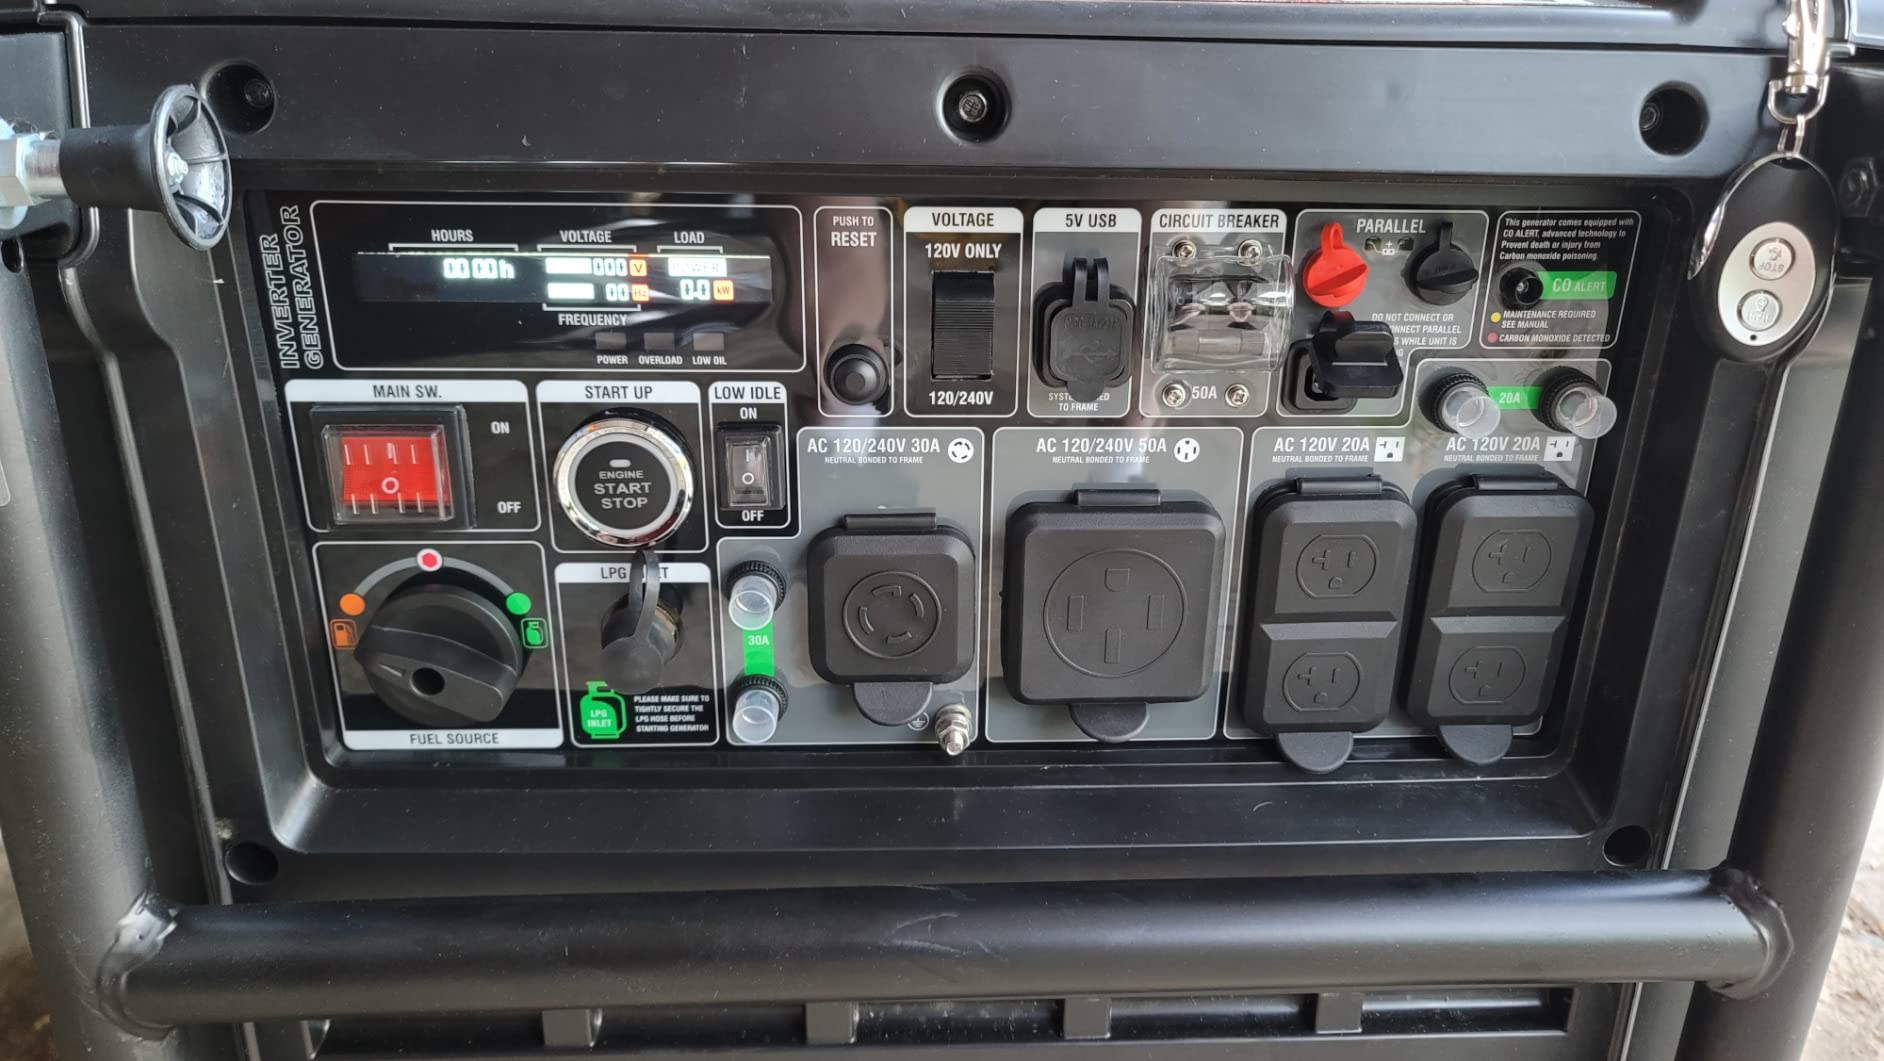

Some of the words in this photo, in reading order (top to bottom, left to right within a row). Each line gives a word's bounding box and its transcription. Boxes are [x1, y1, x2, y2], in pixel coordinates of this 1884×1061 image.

[832, 215, 861, 226] PUSH
[863, 215, 874, 226] TO
[932, 212, 995, 227] VOLTAGE
[1065, 214, 1084, 228] 5V
[1089, 214, 1117, 228] USB
[1159, 214, 1214, 228] CIRCUIT
[1217, 214, 1279, 228] BREAKER
[1505, 218, 1520, 226] This
[1521, 218, 1557, 228] generator
[1583, 218, 1617, 228] equipped
[1618, 218, 1634, 226] with
[1357, 218, 1427, 234] PARALLEL
[431, 230, 473, 242] HOURS
[560, 230, 612, 243] VOLTAGE
[674, 231, 705, 244] LOAD
[831, 231, 877, 247] RESET
[1503, 229, 1514, 238] CO
[1542, 229, 1577, 238] advanced
[1578, 229, 1617, 239] technology
[1618, 229, 1627, 238] to
[925, 243, 960, 259] 120V
[965, 243, 1002, 259] ONLY
[1501, 240, 1529, 249] Prevent
[1530, 240, 1551, 249] death
[1561, 240, 1583, 251] injury
[1583, 240, 1601, 249] from
[1499, 251, 1525, 260] Carbon
[1526, 251, 1561, 260] monoxide
[280, 205, 324, 369] GENERATOR
[1552, 278, 1572, 292] CO
[1574, 281, 1607, 292] ALERT
[260, 234, 300, 368] INVERTER
[558, 313, 627, 326] FREQUENCY
[1371, 313, 1384, 322] DO
[1385, 313, 1402, 322] NOT
[1403, 313, 1441, 322] CONNECT
[1442, 313, 1455, 322] OR
[1502, 310, 1557, 318] MAINTENANCE
[1558, 310, 1596, 318] REQUIRED
[1422, 325, 1461, 334] PARALLEL
[1501, 320, 1516, 328] SEE
[1517, 320, 1549, 328] MANUAL
[1401, 336, 1427, 345] WHILE
[1428, 336, 1447, 345] UNIT
[1448, 336, 1458, 345] IS
[1499, 334, 1530, 342] CARBON
[1531, 334, 1571, 342] MONOXIDE
[1572, 334, 1611, 342] DETECTED
[597, 355, 628, 364] POWER
[638, 355, 682, 364] OVERLOAD
[692, 356, 711, 365] LOW
[713, 356, 727, 365] OIL
[373, 385, 410, 398] MAIN
[415, 385, 442, 398] SW.
[585, 386, 629, 399] START
[633, 386, 653, 399] UP
[714, 387, 745, 400] LOW
[750, 387, 781, 400] IDLE
[1191, 386, 1217, 400] 50A
[929, 391, 993, 406] 120/240V
[1499, 392, 1520, 404] 20A
[1059, 402, 1069, 411] TO
[1071, 402, 1099, 411] FRAME
[739, 407, 757, 419] ON
[491, 421, 510, 434] ON
[807, 438, 828, 453] AC
[833, 438, 906, 454] 120/240V
[911, 438, 940, 453] 30A
[1036, 438, 1057, 453] AC
[1062, 438, 1134, 454] 120/240V
[1138, 438, 1167, 453] 50A
[1273, 437, 1294, 452] AC
[1300, 437, 1338, 452] 120V
[1341, 437, 1370, 452] 20A
[1446, 437, 1467, 451] AC
[1471, 437, 1509, 451] 120V
[1512, 437, 1540, 451] 20A
[824, 456, 856, 464] NEUTRAL
[858, 456, 886, 464] BONDED
[888, 456, 897, 464] TO
[899, 456, 924, 464] FRAME
[1052, 456, 1084, 464] NEUTRAL
[1085, 456, 1114, 464] BONDED
[1115, 456, 1125, 464] TO
[1126, 456, 1150, 464] FRAME
[1272, 455, 1303, 463] NEUTRAL
[1304, 455, 1333, 463] BONDED
[1334, 455, 1344, 463] TO
[1344, 455, 1369, 463] FRAME
[1444, 454, 1473, 462] NEUTRAL
[1476, 454, 1503, 462] BONDED
[1503, 454, 1513, 462] TO
[1514, 454, 1539, 462] FRAME
[599, 470, 644, 480] ENGINE
[593, 482, 652, 495] START
[497, 501, 521, 514] OFF
[601, 497, 649, 509] STOP
[741, 510, 764, 522] OFF
[601, 567, 627, 579] LPG
[748, 635, 769, 645] 30A
[633, 695, 659, 703] PLEASE
[660, 695, 679, 703] MAKE
[680, 695, 699, 703] SURE
[590, 709, 607, 718] LPG
[634, 705, 662, 713] TIGHTLY
[587, 719, 612, 728] INLET
[635, 715, 649, 723] LPG
[669, 714, 696, 722] BEFORE
[669, 724, 709, 732] GENERATOR
[409, 733, 442, 745] FUEL
[446, 733, 500, 745] SOURCE
